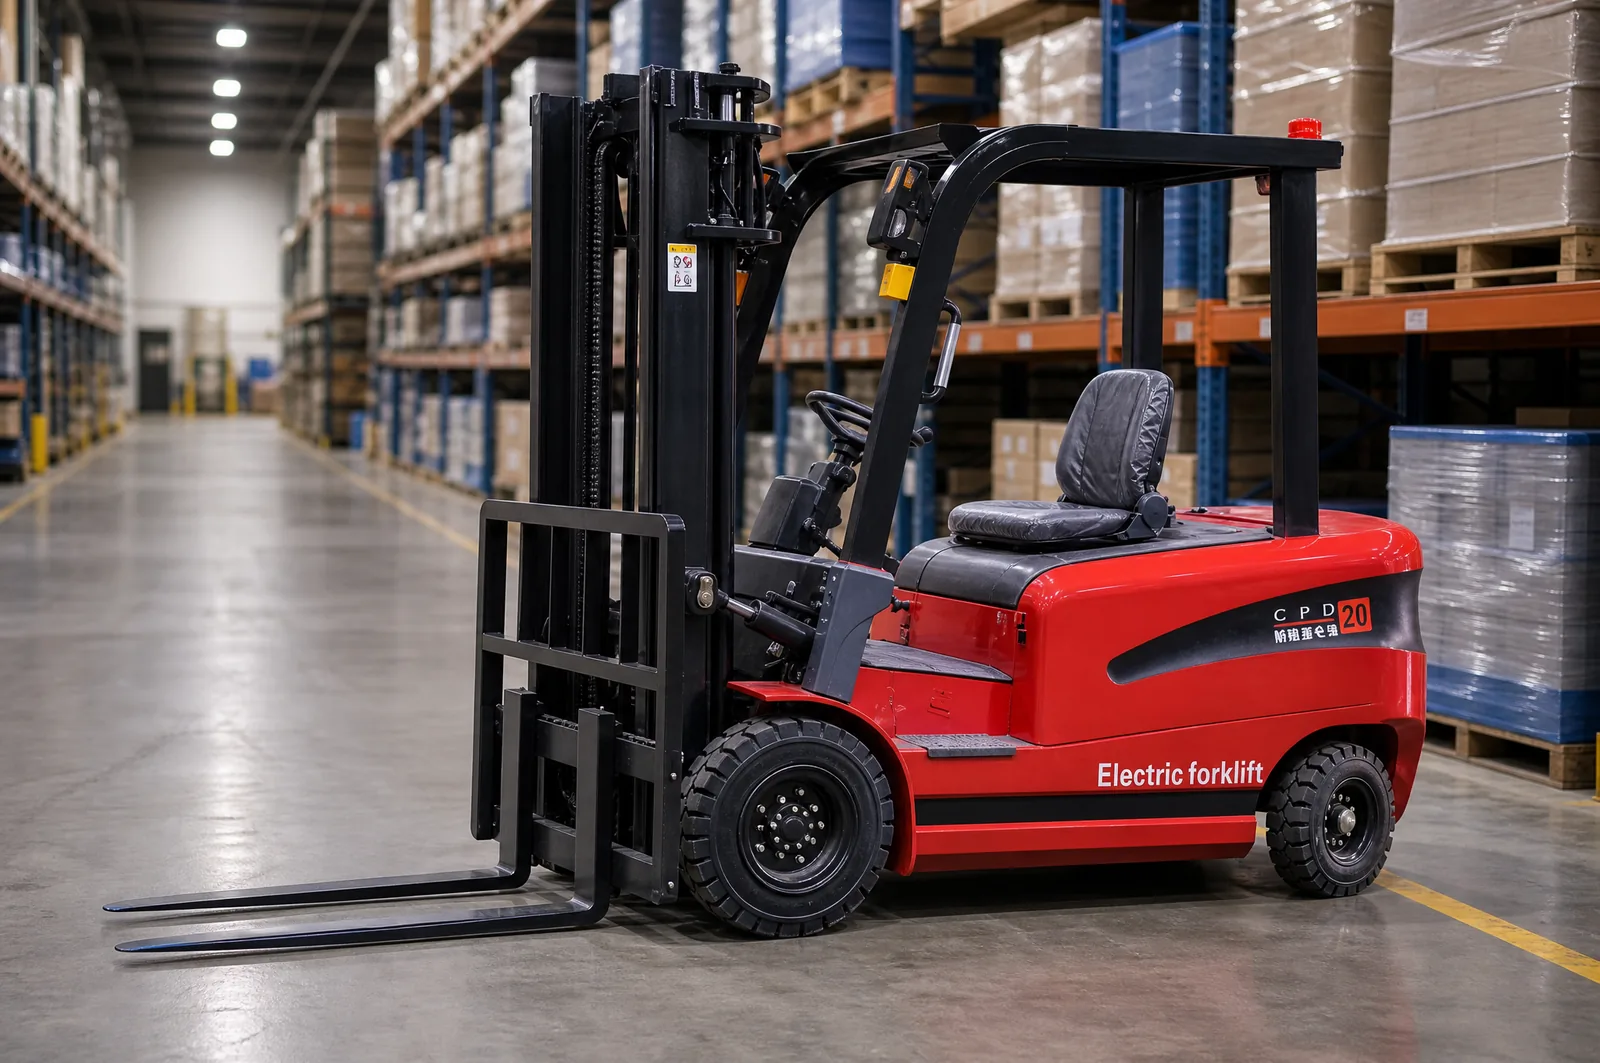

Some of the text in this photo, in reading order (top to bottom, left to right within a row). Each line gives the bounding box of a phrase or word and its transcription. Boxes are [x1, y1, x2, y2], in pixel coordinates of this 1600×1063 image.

[1342, 603, 1368, 628] 20
[1098, 760, 1264, 787] Electric forklift
